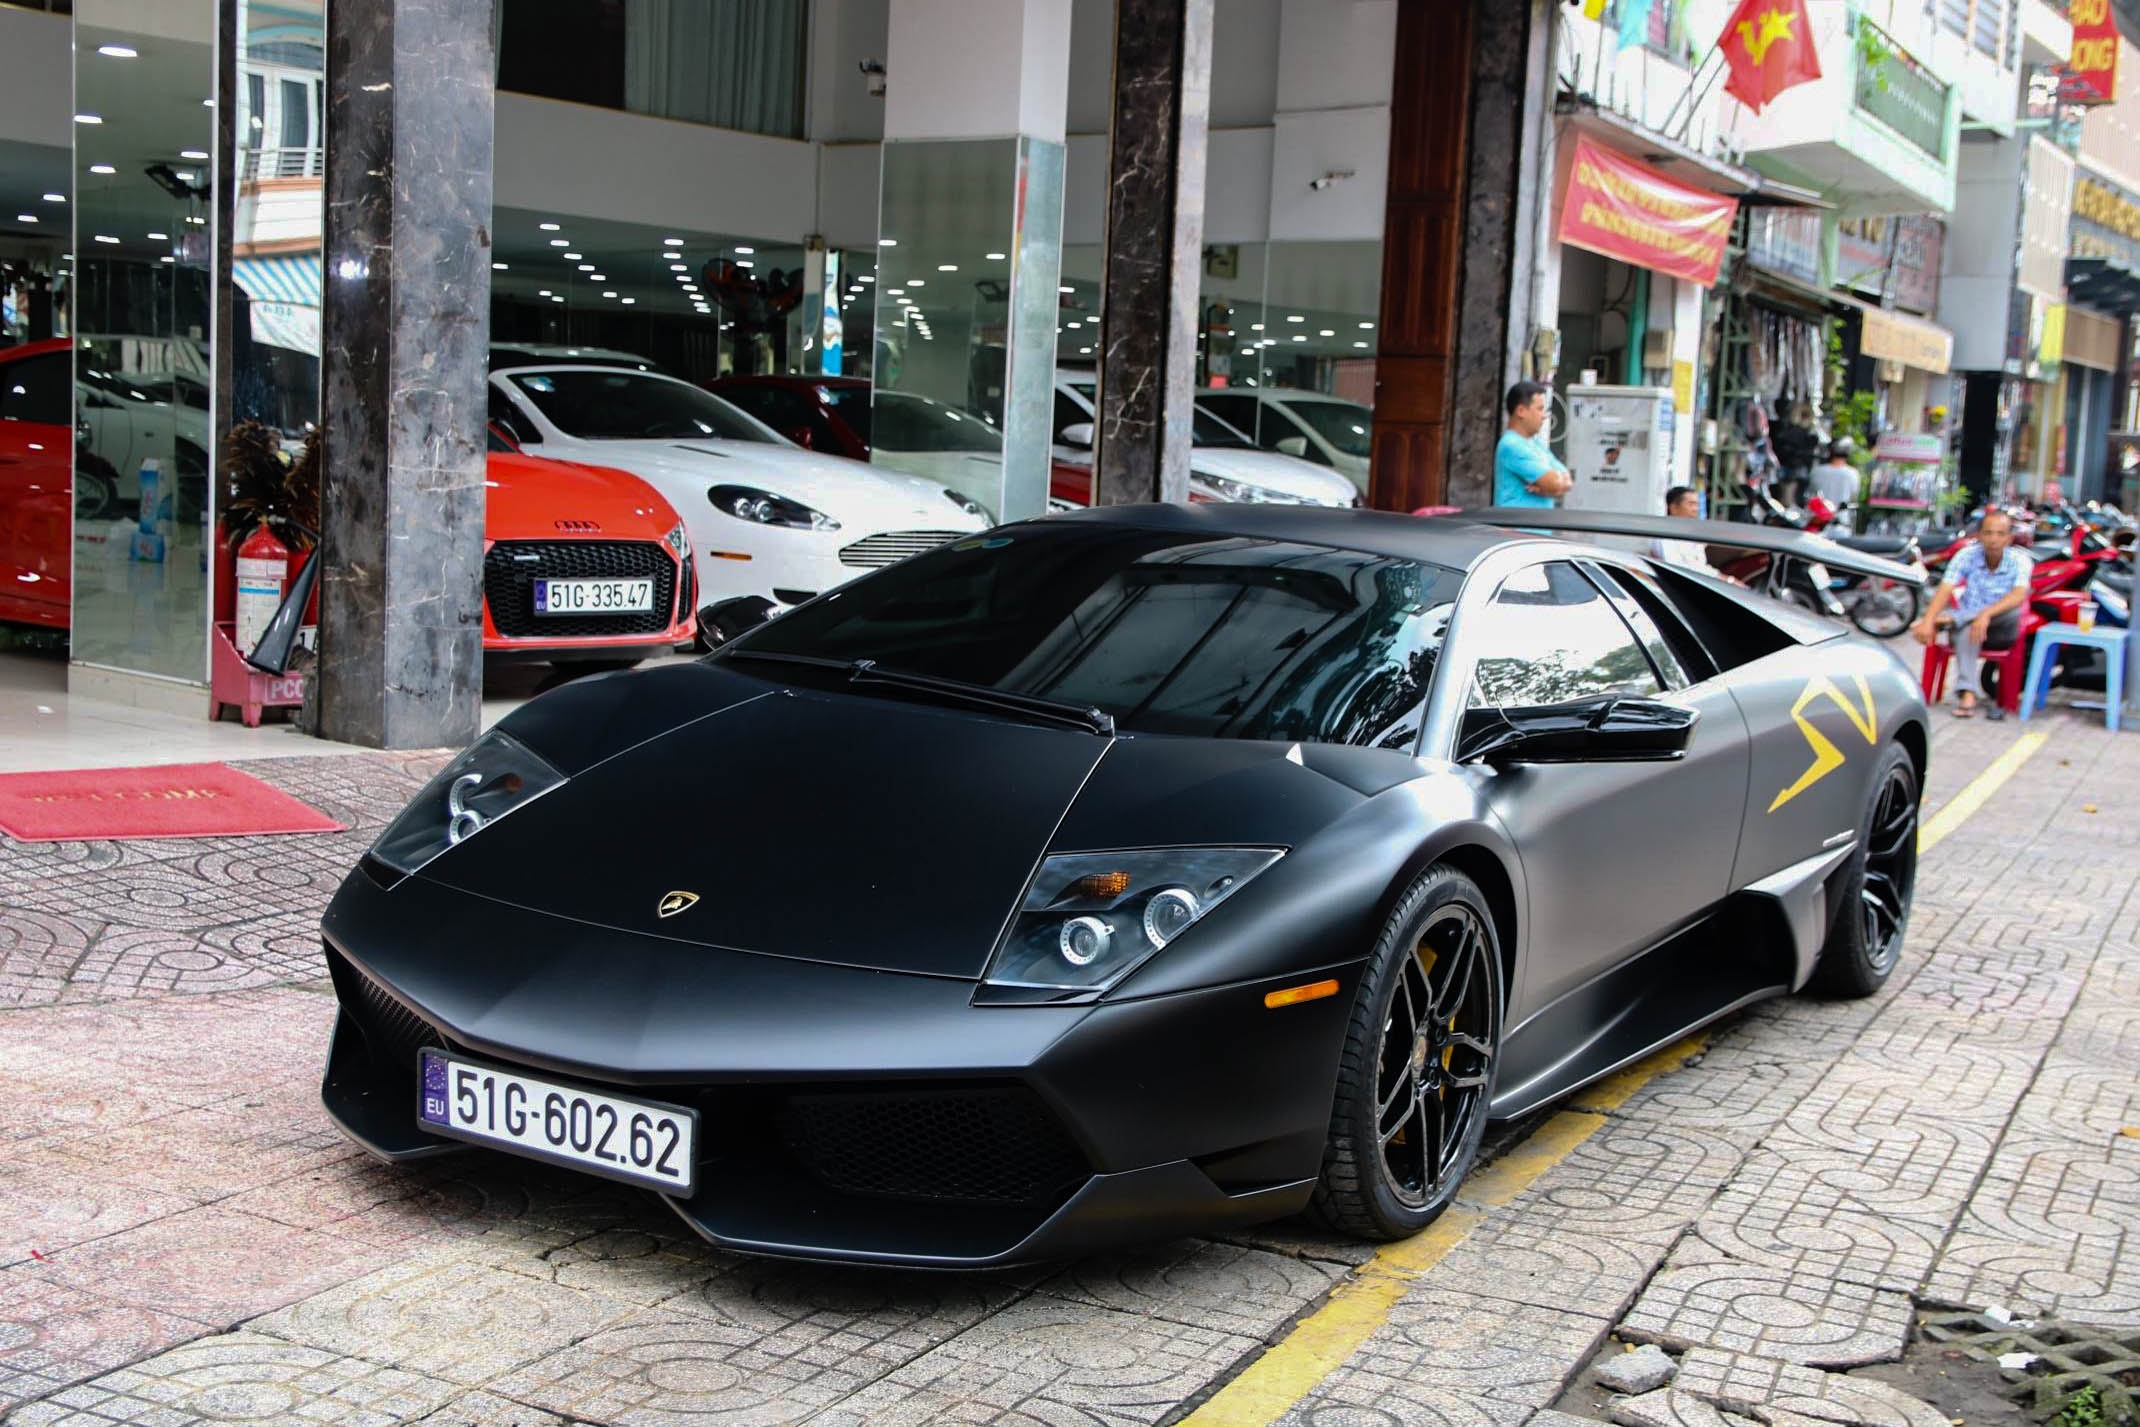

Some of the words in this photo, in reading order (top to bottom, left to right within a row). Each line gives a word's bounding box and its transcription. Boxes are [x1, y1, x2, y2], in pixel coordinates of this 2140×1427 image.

[552, 584, 648, 608] 51G-335.47
[427, 1098, 444, 1115] EU
[456, 1069, 680, 1177] 51G-602.62
